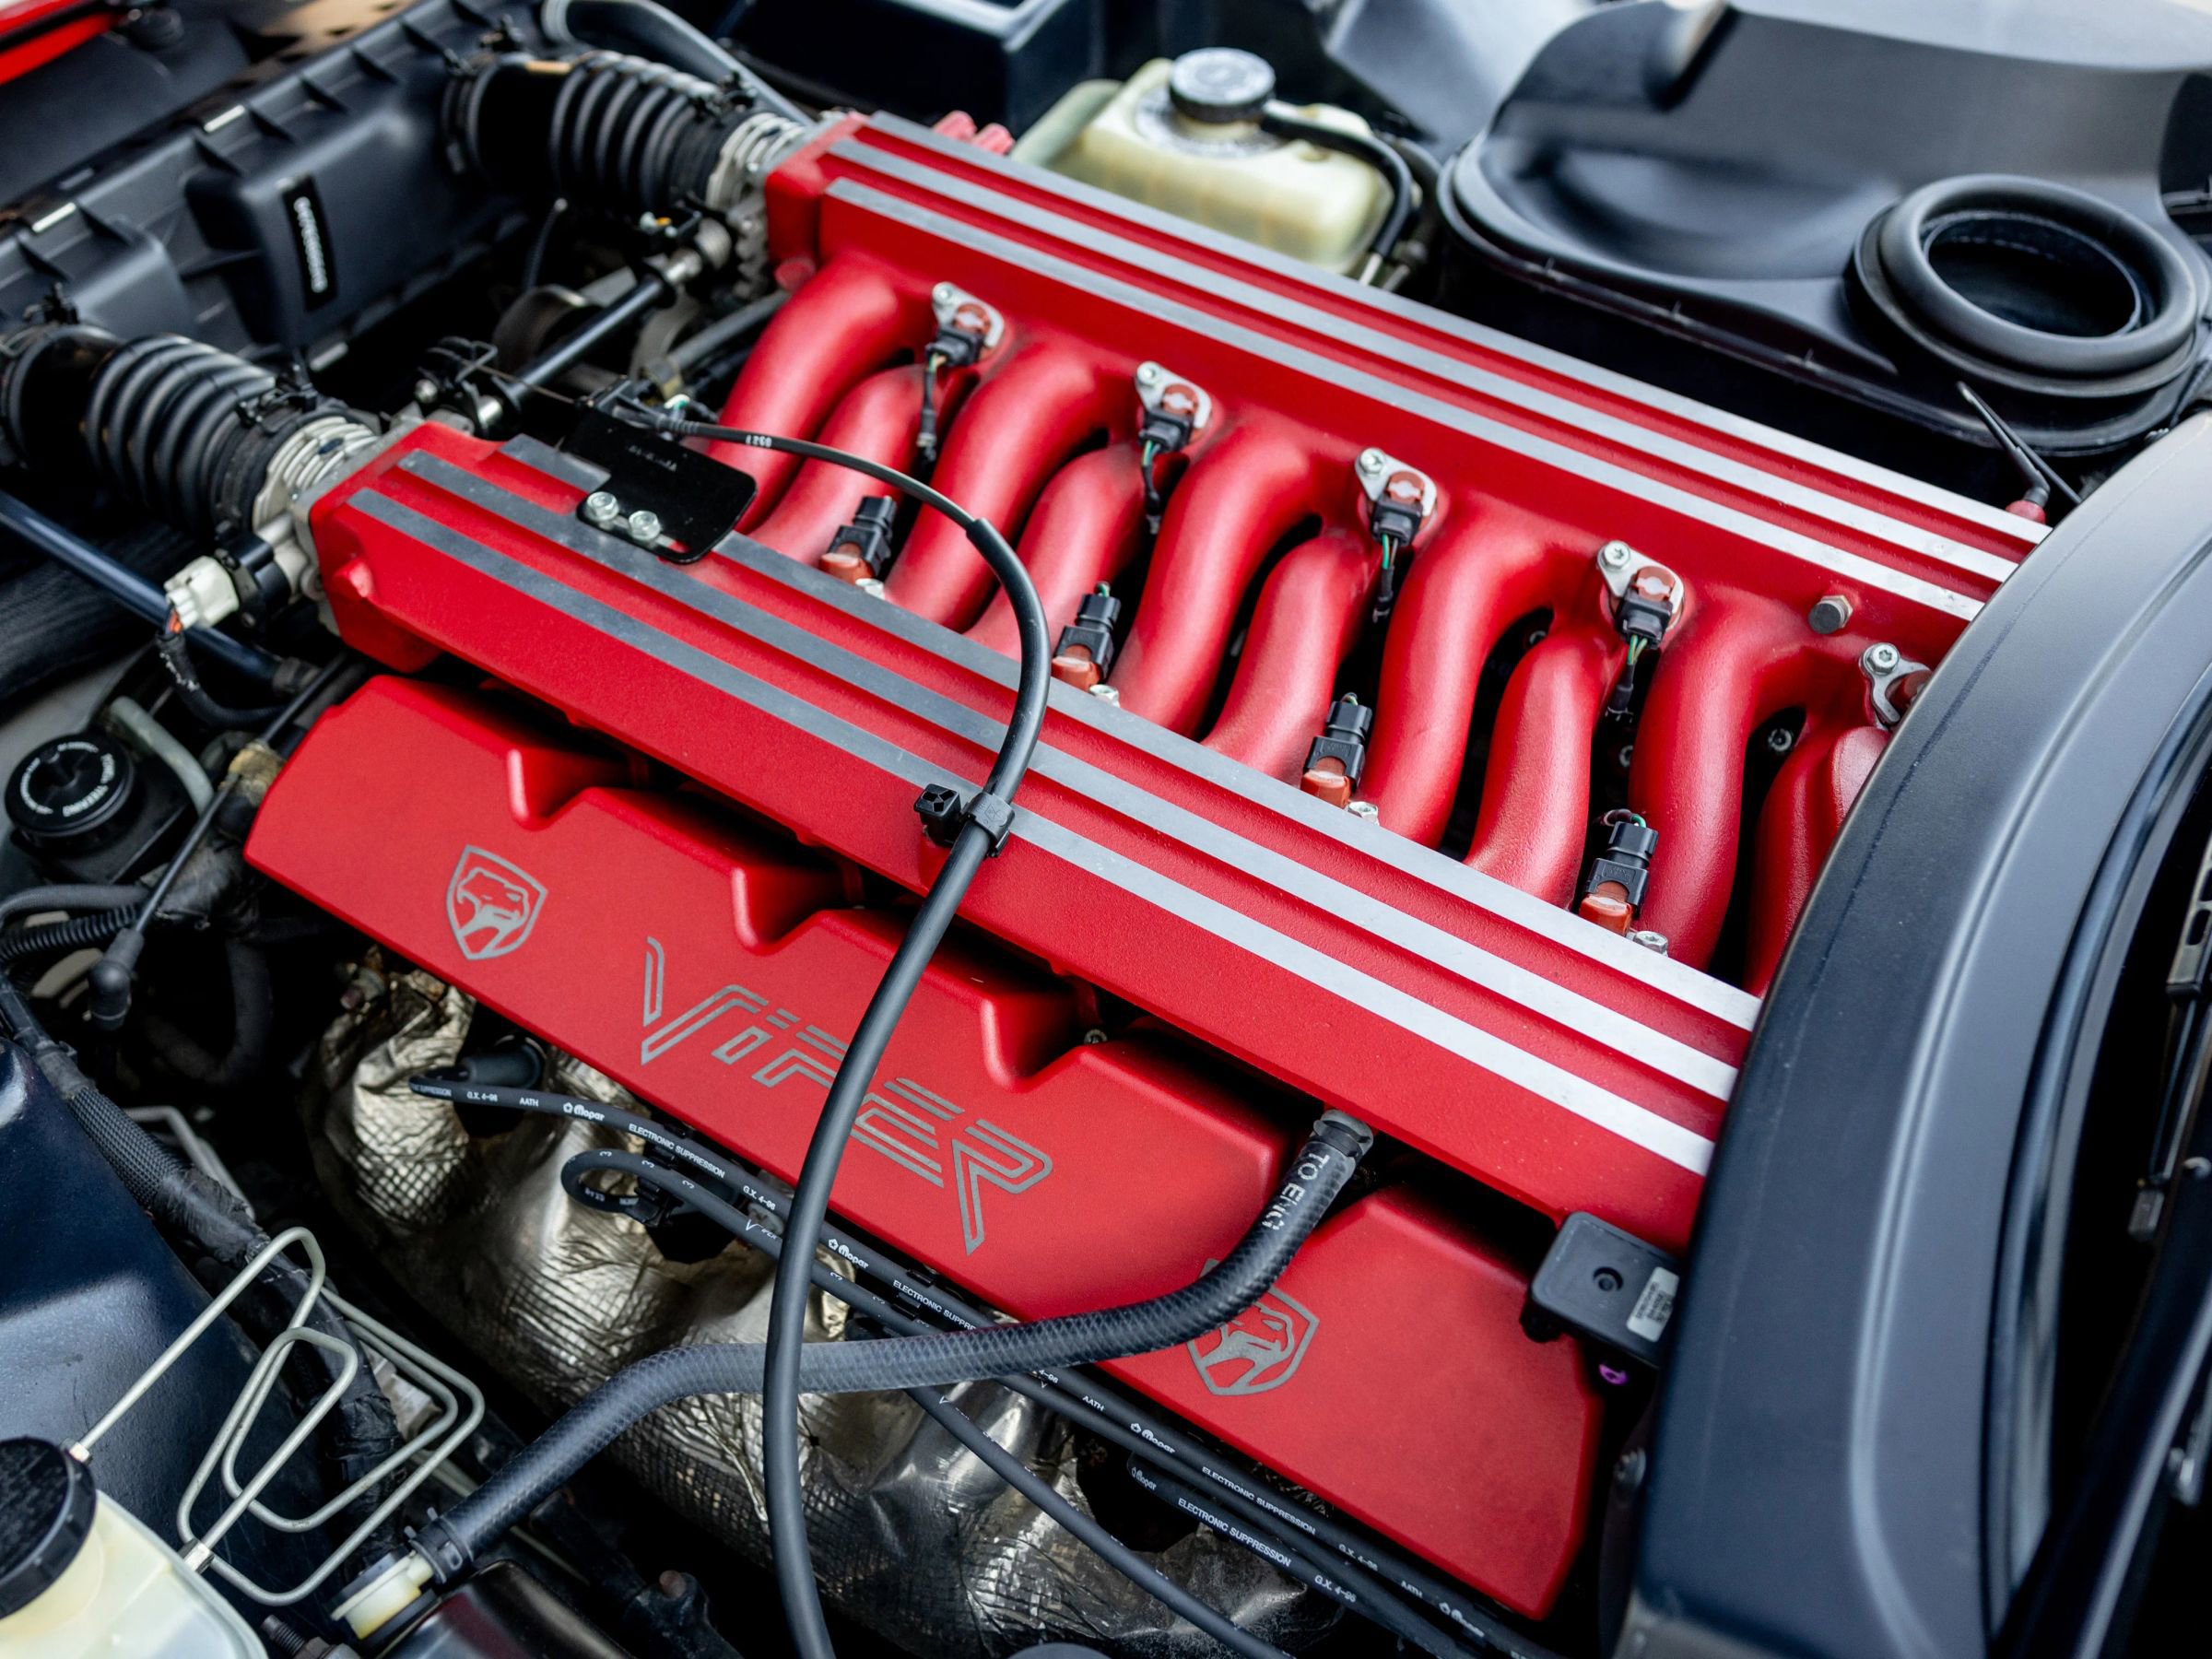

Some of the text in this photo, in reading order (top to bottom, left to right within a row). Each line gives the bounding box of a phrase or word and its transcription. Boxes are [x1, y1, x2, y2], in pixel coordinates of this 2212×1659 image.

[520, 1097, 539, 1107] AATH
[573, 1104, 605, 1122] Mopar
[629, 1124, 675, 1150] ELECTRONIC
[675, 1146, 725, 1179] SUPPRESSION
[1297, 1153, 1331, 1181] TO
[838, 1244, 869, 1269] Mopar
[893, 1279, 942, 1313] ELECTRONIC
[1082, 1395, 1105, 1412] AATH
[1178, 1497, 1230, 1533] ELECTRONIC
[1230, 1526, 1292, 1568] SUPPRESSION
[1201, 1466, 1255, 1501] ELECTRONIC
[1255, 1497, 1316, 1535] SUPPRESSION
